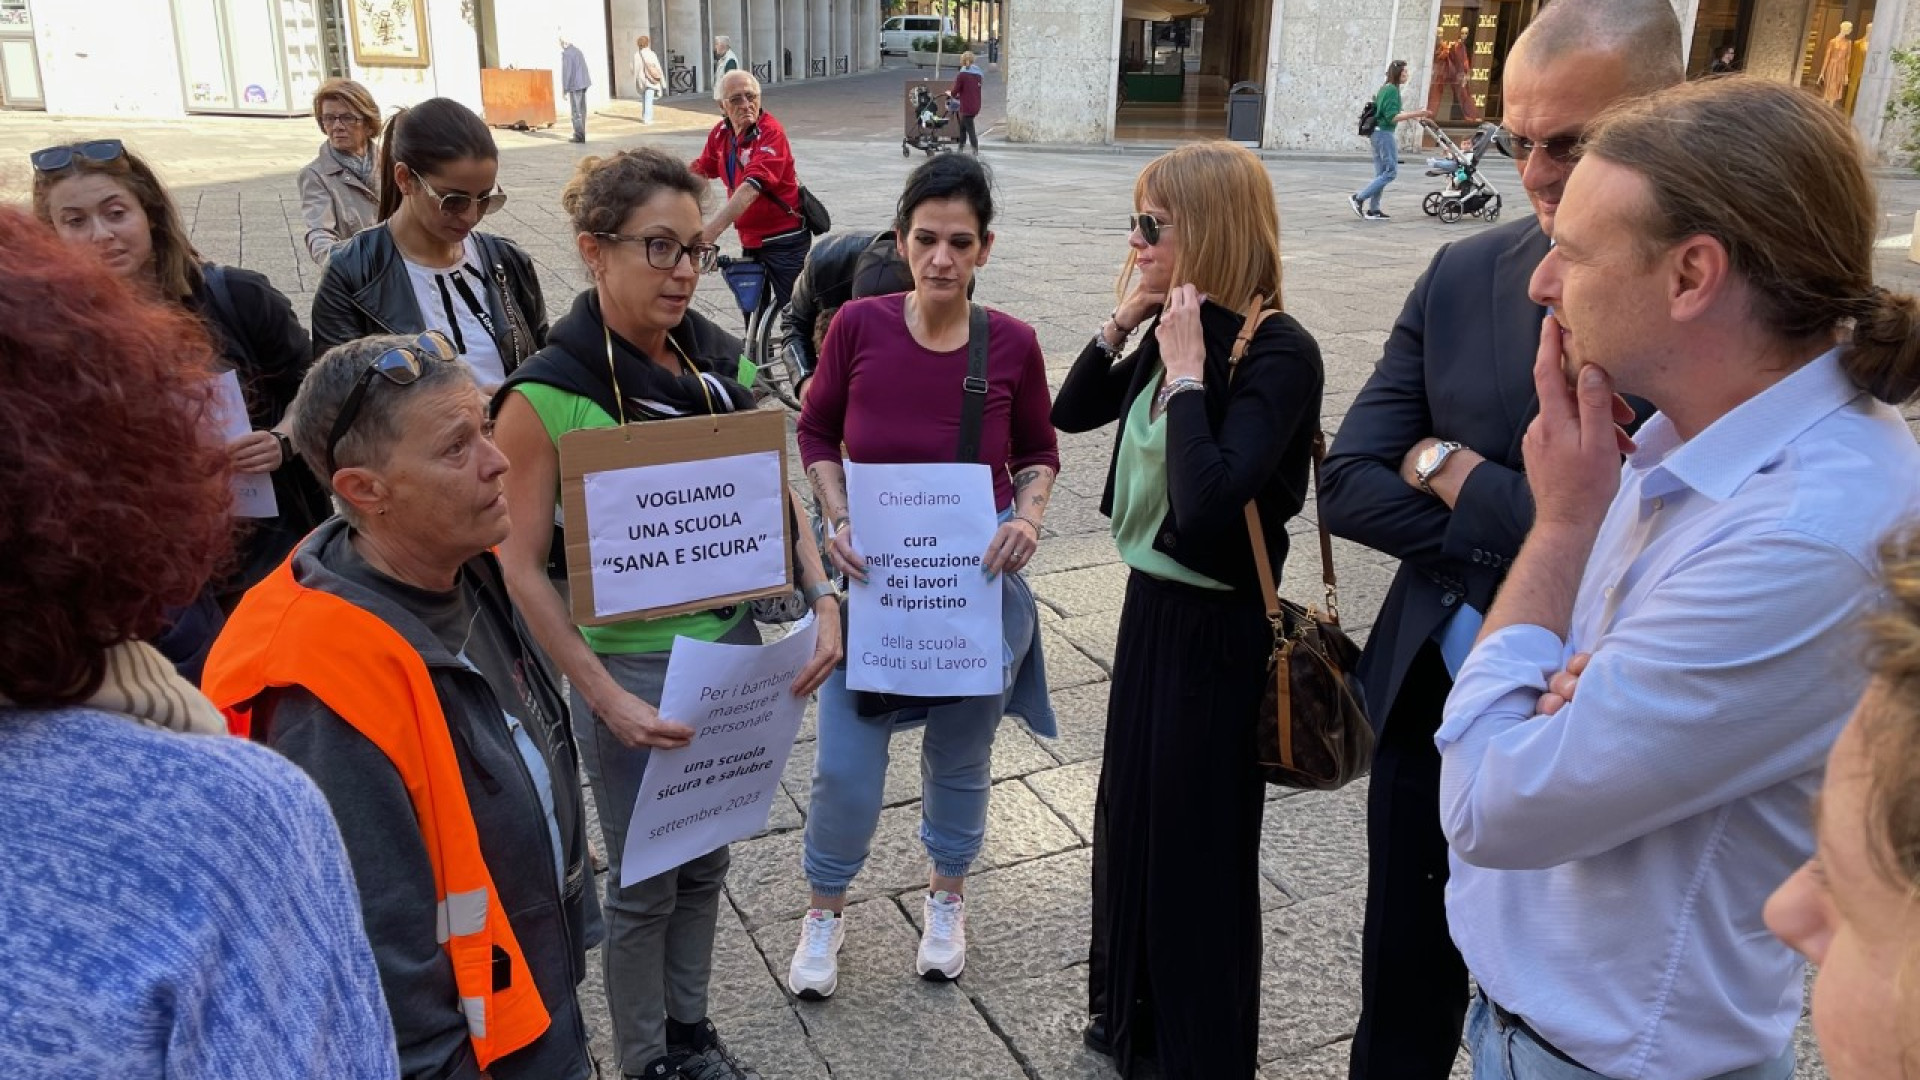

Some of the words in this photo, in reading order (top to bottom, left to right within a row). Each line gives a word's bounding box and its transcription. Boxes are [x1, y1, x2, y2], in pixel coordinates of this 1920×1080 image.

[636, 482, 735, 509] VOGLIAMO
[879, 491, 961, 506] Chiediamo
[628, 521, 670, 541] UNA
[674, 511, 742, 535] SCUOLA
[602, 551, 670, 574] “SANA
[675, 548, 685, 565] E
[691, 533, 767, 562] SICURA”
[903, 535, 937, 547] cura
[887, 574, 909, 589] dei
[914, 573, 958, 589] lavori
[880, 593, 893, 607] di
[897, 594, 967, 612] ripristino
[881, 633, 913, 650] della
[918, 635, 967, 650] scuola
[862, 652, 906, 670] Caduti
[911, 656, 932, 670] sul
[937, 656, 987, 670] Lavoro
[700, 685, 729, 702] Per
[731, 683, 739, 698] i
[741, 667, 795, 696] bambini
[707, 696, 769, 719] maestre
[770, 691, 780, 702] e
[699, 710, 773, 738] personale
[684, 758, 714, 774] una
[718, 746, 766, 766] scuola
[656, 776, 702, 801] sicura
[705, 775, 716, 786] e
[718, 759, 773, 782] salubre
[649, 807, 722, 839] settembre
[725, 791, 760, 812] 2023
